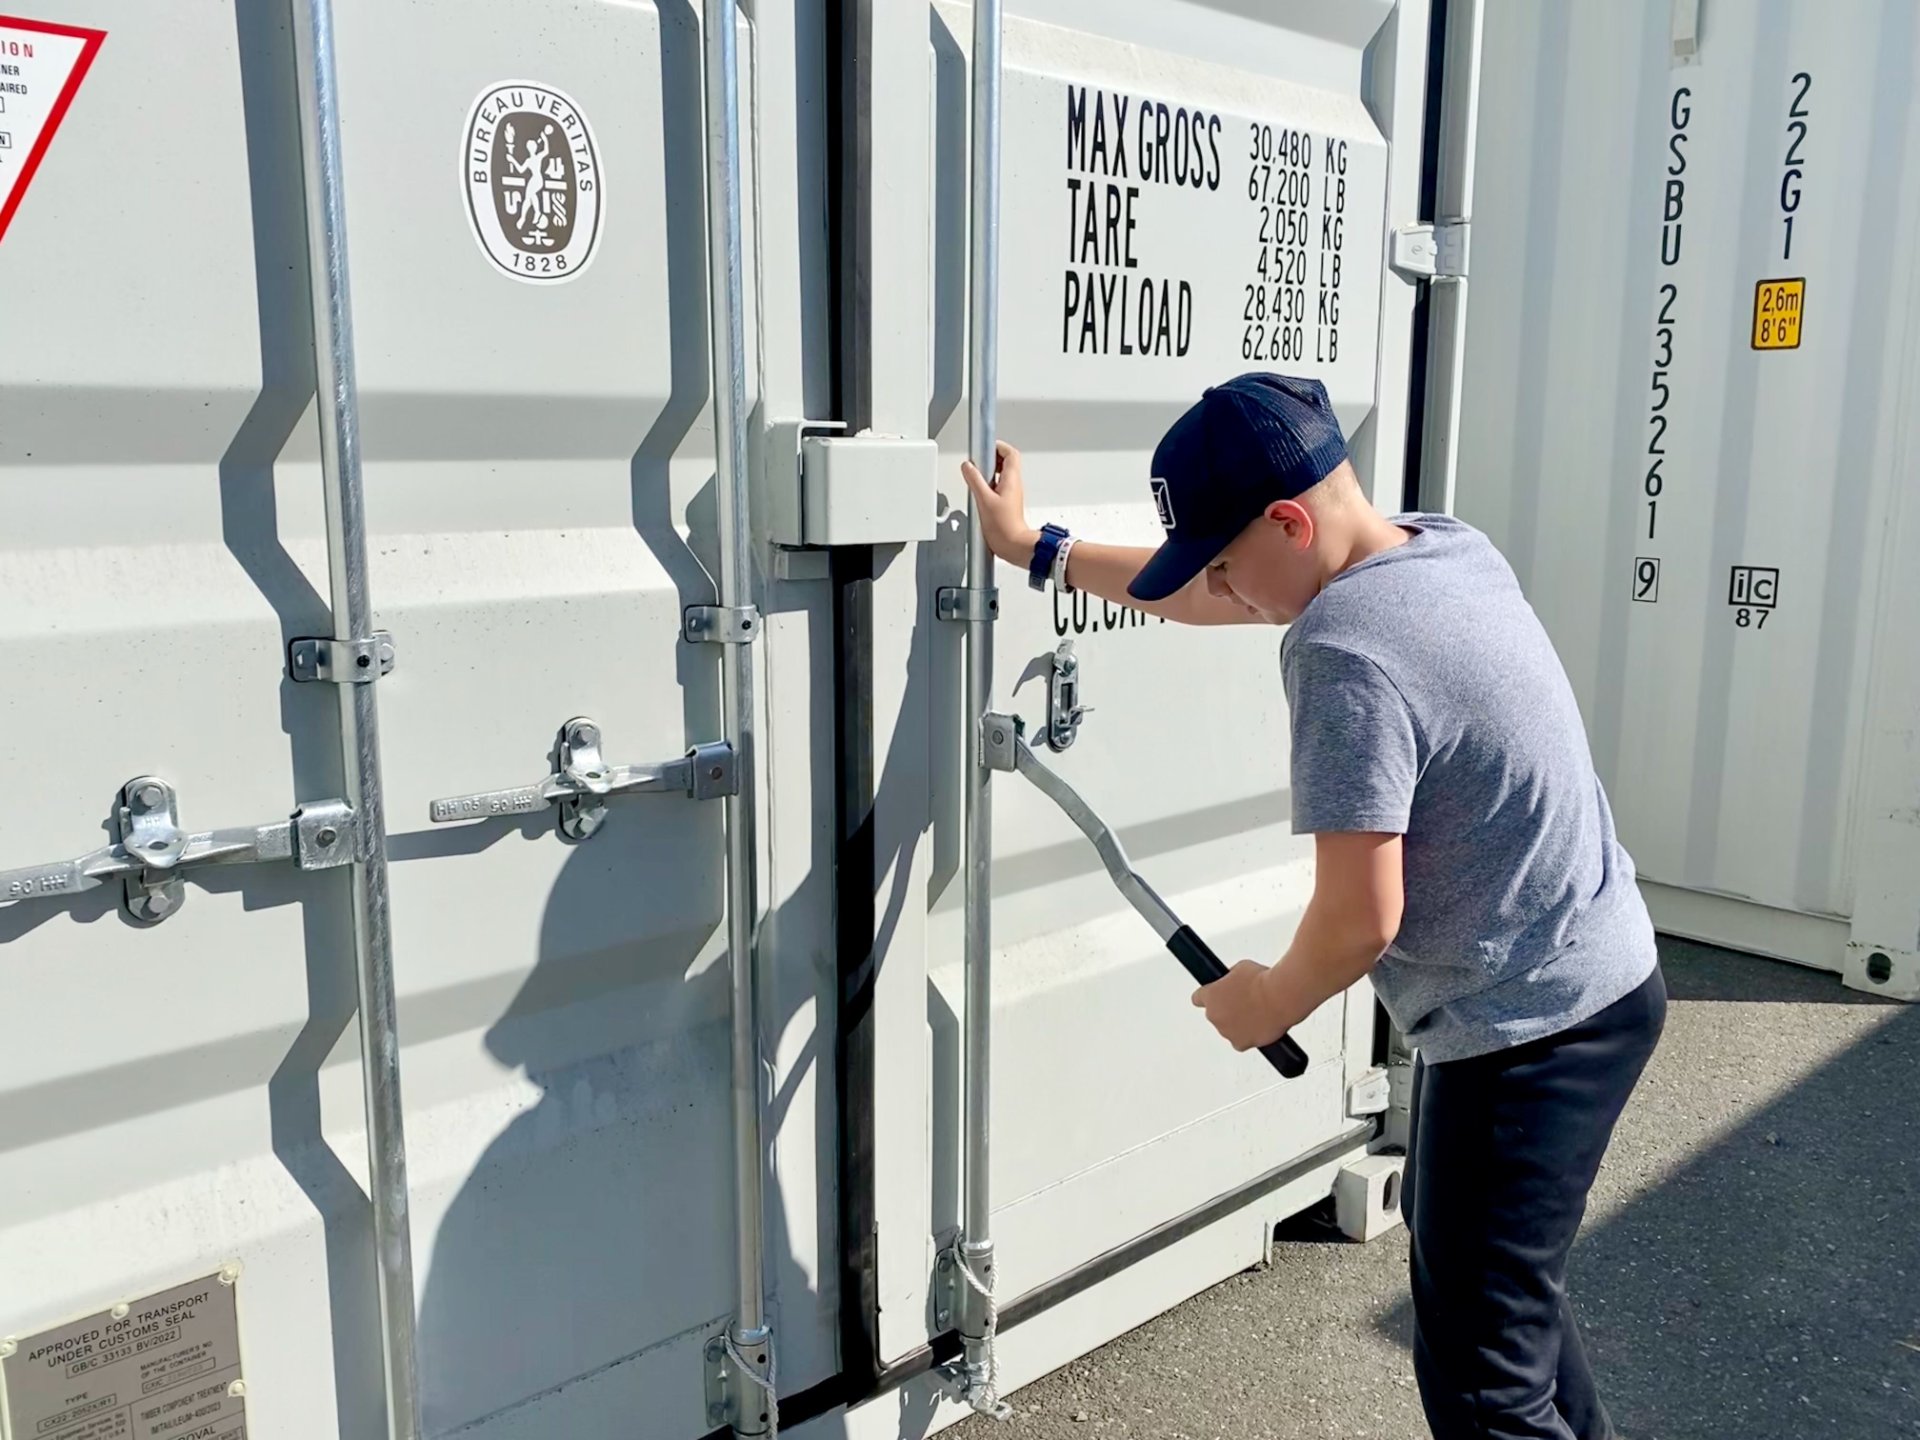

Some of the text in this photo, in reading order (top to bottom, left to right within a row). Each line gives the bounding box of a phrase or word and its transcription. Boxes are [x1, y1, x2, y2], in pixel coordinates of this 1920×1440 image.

[473, 91, 593, 192] BUREAU VERITAS
[1067, 85, 1348, 191] MAX GROSS 30,480 KG
[1780, 72, 1812, 260] 22G1
[1067, 178, 1344, 268] TARE 2,050 KG
[1323, 176, 1346, 214] LB
[512, 253, 567, 272] 1828
[1319, 252, 1342, 289] LB
[1062, 270, 1340, 357] PAYLOAD 28,430 KG
[1762, 286, 1799, 316] 2,6m
[1242, 324, 1338, 363] 62,680 LB
[1637, 87, 1692, 599] GSBU 235261 9
[1735, 608, 1770, 630] 87
[28, 1292, 209, 1362] APPROVED FOR TRANSPORT
[47, 1310, 195, 1368] UNDER CUSTOMS SEAL
[65, 1392, 88, 1405] TYPE
